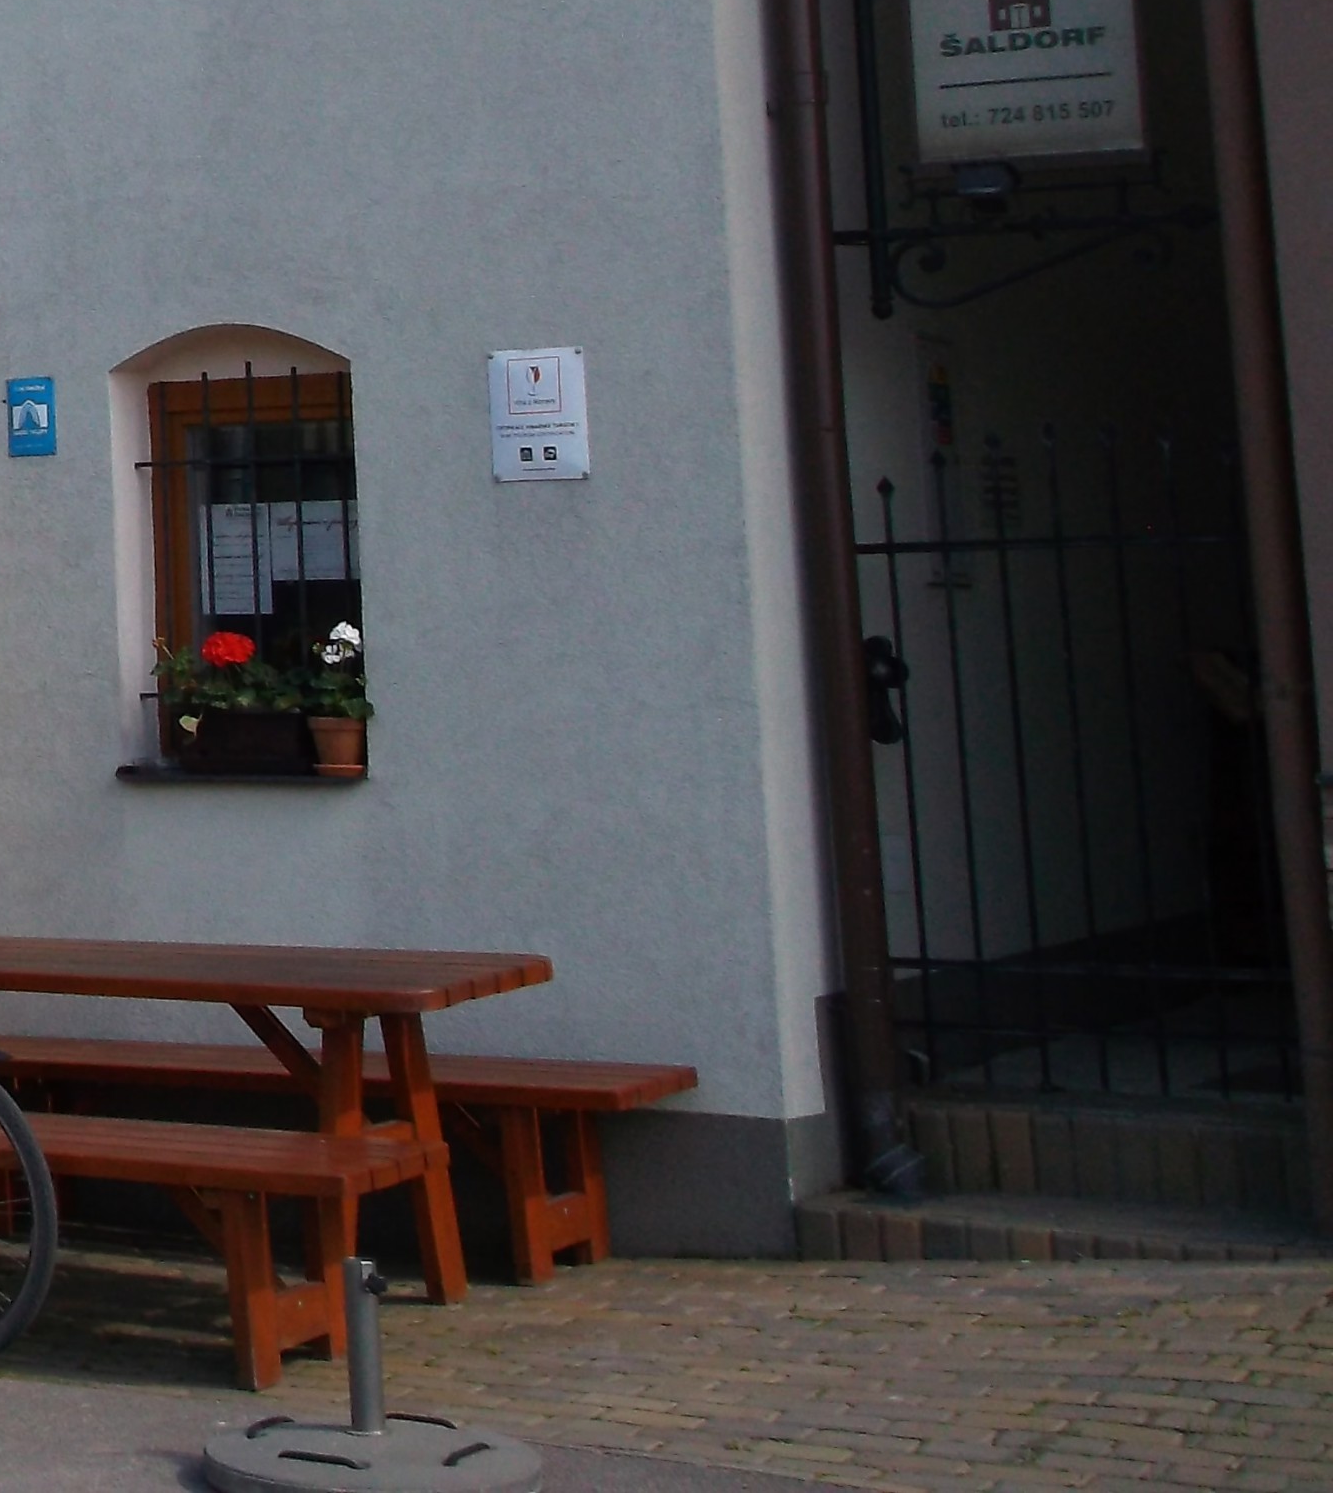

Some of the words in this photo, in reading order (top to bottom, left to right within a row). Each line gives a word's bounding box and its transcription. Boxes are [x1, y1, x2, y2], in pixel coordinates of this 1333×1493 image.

[939, 26, 1106, 57] ŠALDORF
[941, 111, 980, 129] tel.:
[988, 107, 1026, 125] 724
[1033, 103, 1071, 122] 815
[1079, 99, 1115, 119] 507
